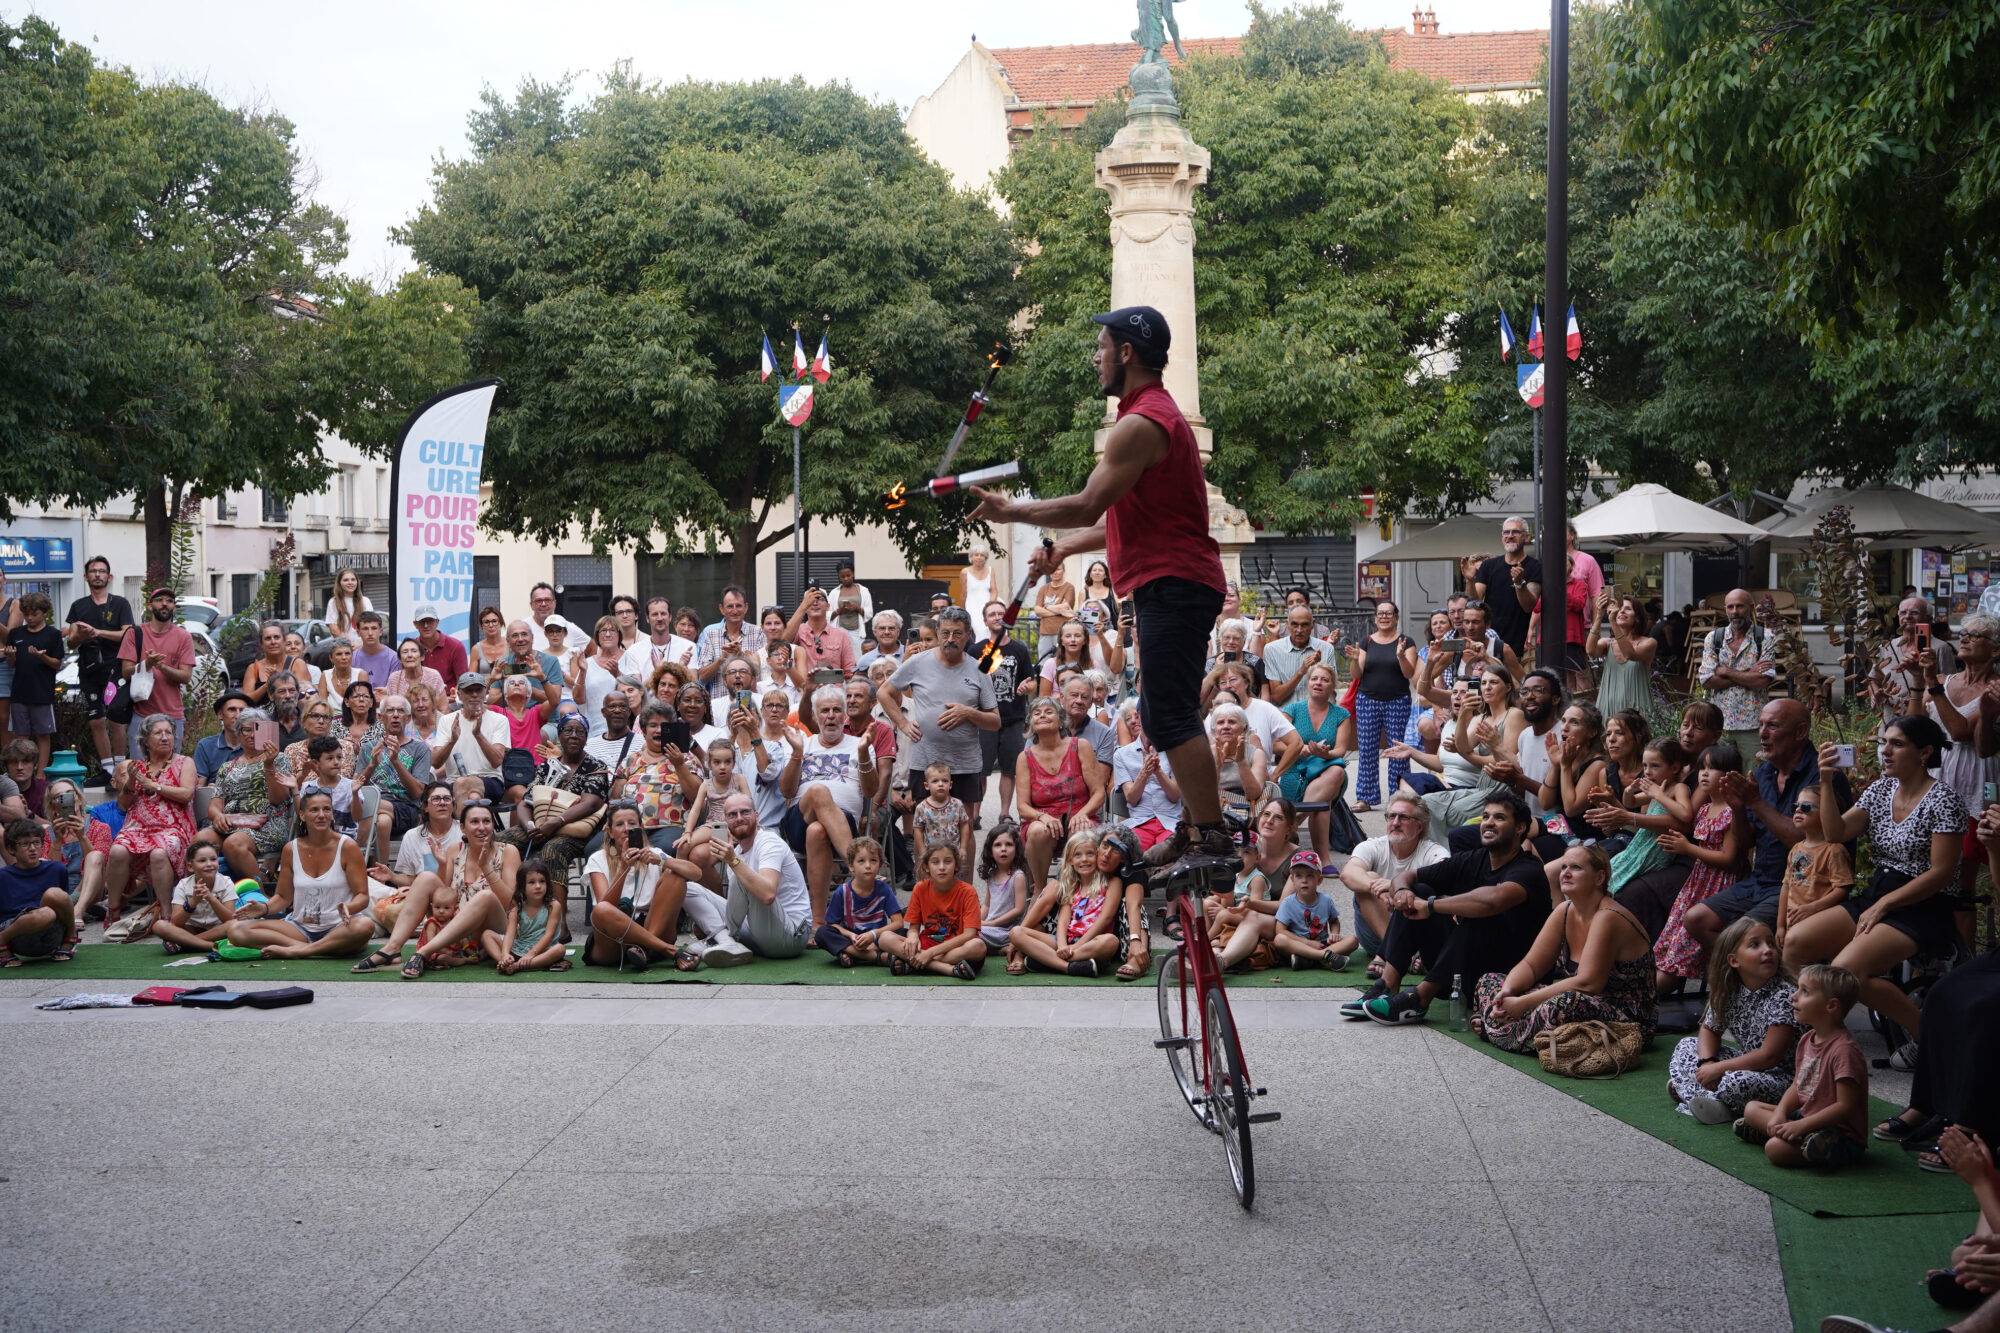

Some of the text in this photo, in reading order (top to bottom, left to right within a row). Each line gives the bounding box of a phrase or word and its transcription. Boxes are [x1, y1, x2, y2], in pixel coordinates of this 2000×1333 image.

[419, 440, 484, 468] CULT
[427, 468, 481, 495] URE
[406, 494, 477, 521] POUR
[408, 522, 475, 548] TOUS
[424, 550, 473, 575] PAR
[409, 577, 474, 602] TOUT
